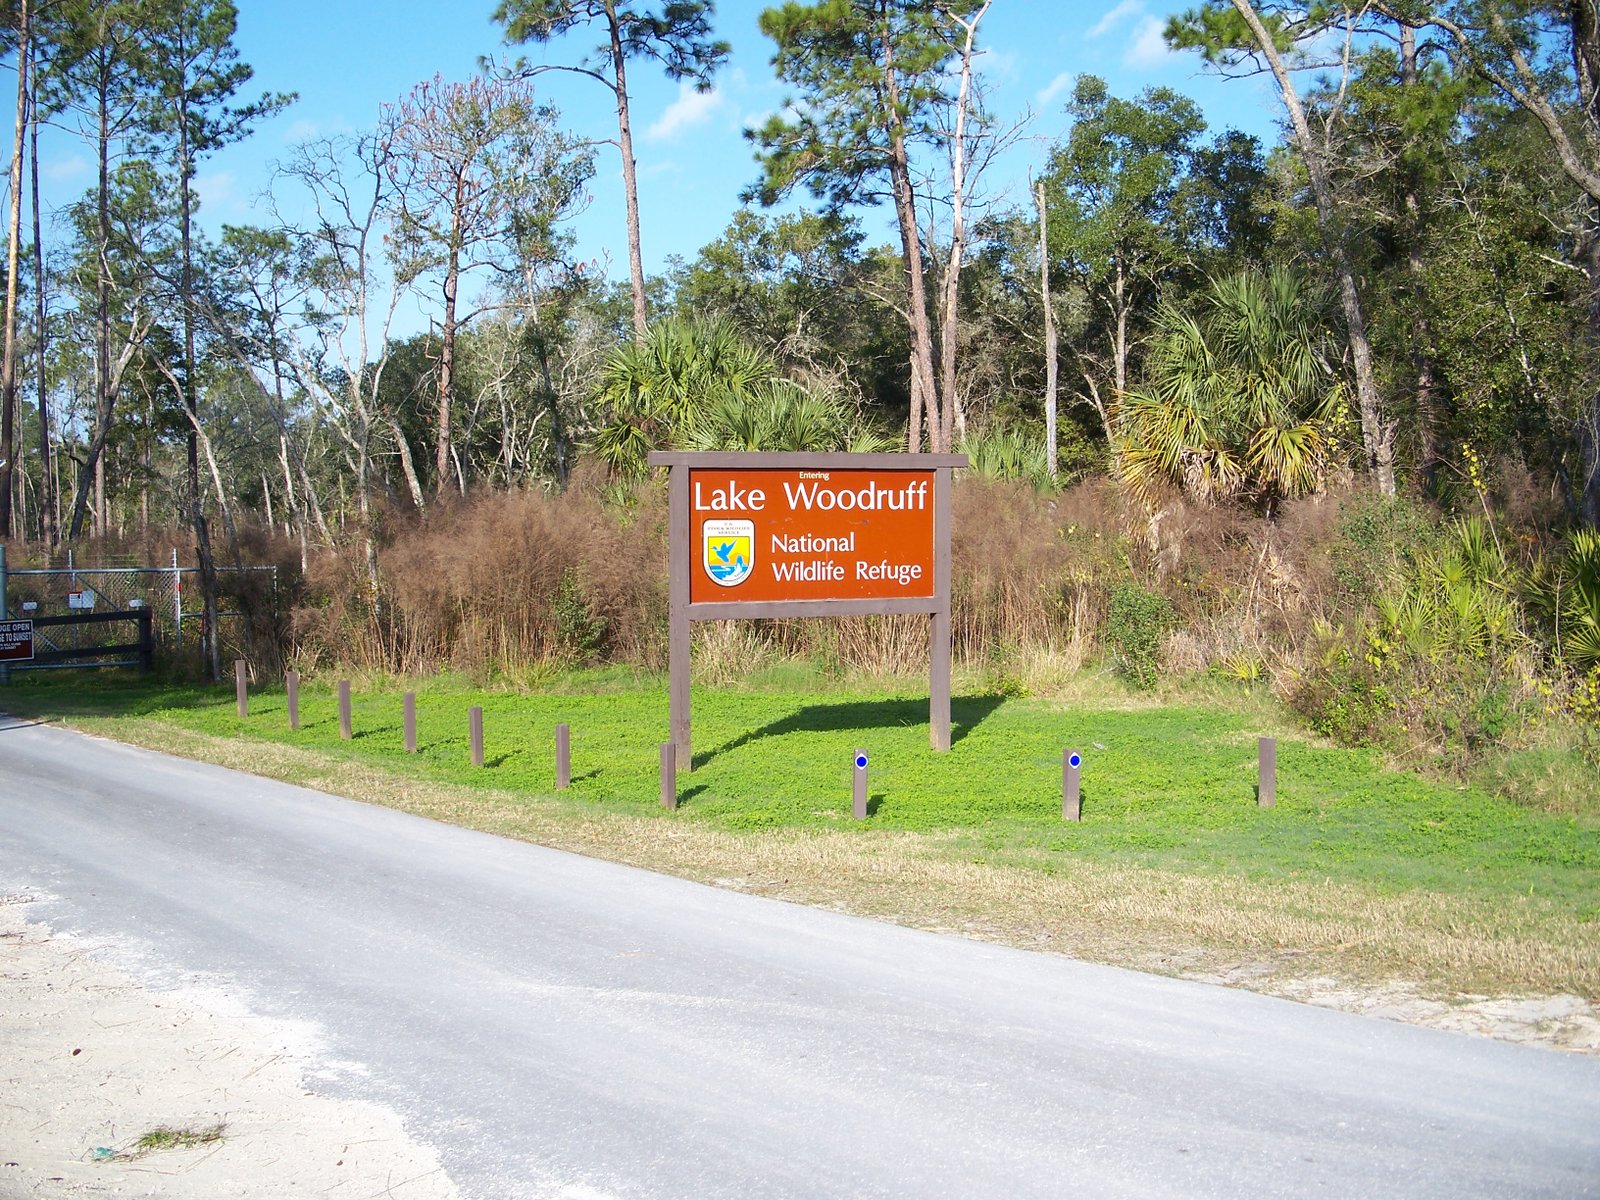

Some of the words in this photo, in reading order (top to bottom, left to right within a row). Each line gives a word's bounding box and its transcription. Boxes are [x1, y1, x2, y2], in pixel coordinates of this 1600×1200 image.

[799, 471, 829, 481] Entering
[695, 480, 766, 511] Lake
[783, 480, 928, 511] Woodruff
[771, 531, 855, 553] National
[771, 560, 845, 582] Wildlife
[856, 559, 922, 585] Refuge
[6, 633, 12, 641] TO
[13, 632, 31, 641] SUNSET
